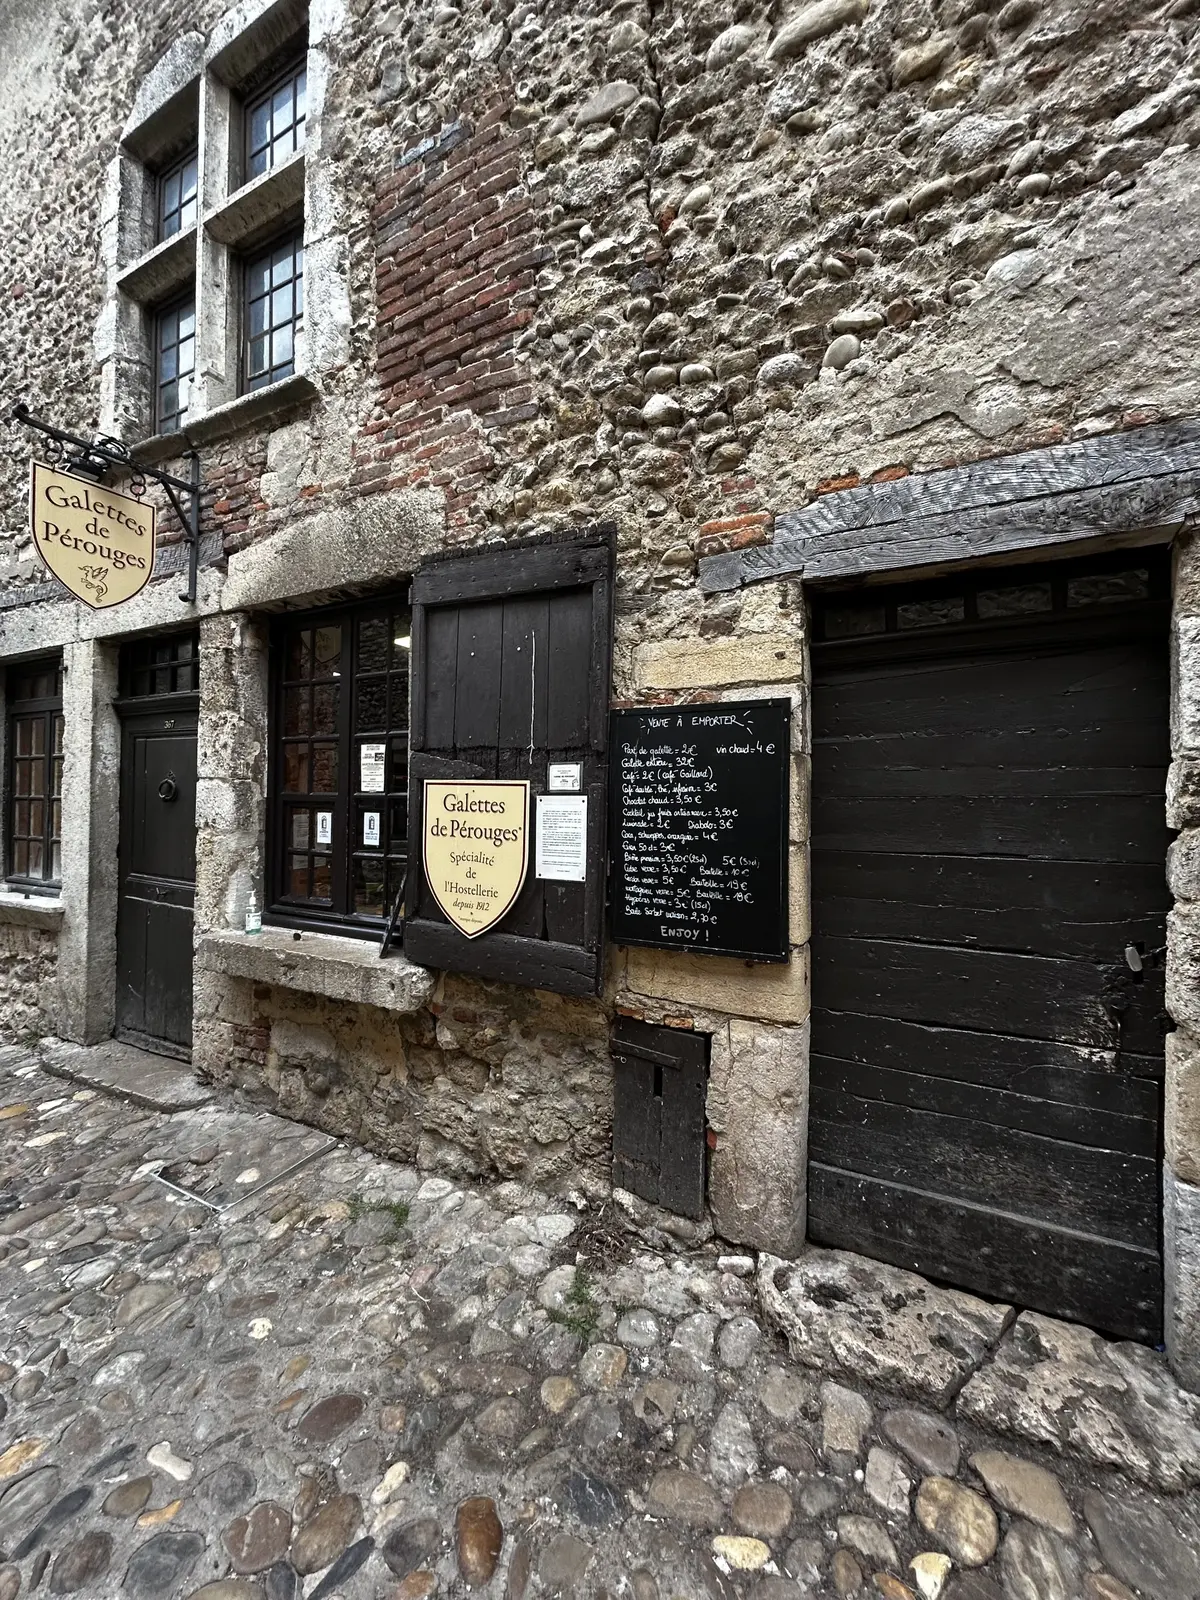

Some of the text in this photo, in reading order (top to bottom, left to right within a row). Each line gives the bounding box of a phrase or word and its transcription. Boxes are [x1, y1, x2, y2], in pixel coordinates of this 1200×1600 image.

[45, 485, 147, 537] Galettes
[85, 517, 110, 538] de
[42, 520, 146, 569] Pérouges
[648, 717, 671, 728] VENTE
[691, 714, 745, 727] EMPORTER
[638, 746, 648, 755] de
[716, 744, 727, 754] vin
[728, 743, 749, 754] chaud
[680, 766, 714, 780] Gaillard)
[443, 793, 506, 814] Galettes
[647, 795, 670, 804] chaud
[687, 819, 714, 830] Diabolo
[719, 819, 734, 829] 3€
[430, 817, 448, 837] de
[449, 819, 518, 848] Pérouges
[702, 831, 719, 841] 4€
[449, 850, 495, 867] Spécialité
[465, 866, 477, 879] de
[444, 880, 499, 899] l'Hostellerie
[452, 897, 490, 911] depuis 1912
[660, 925, 700, 940] ENJOY
